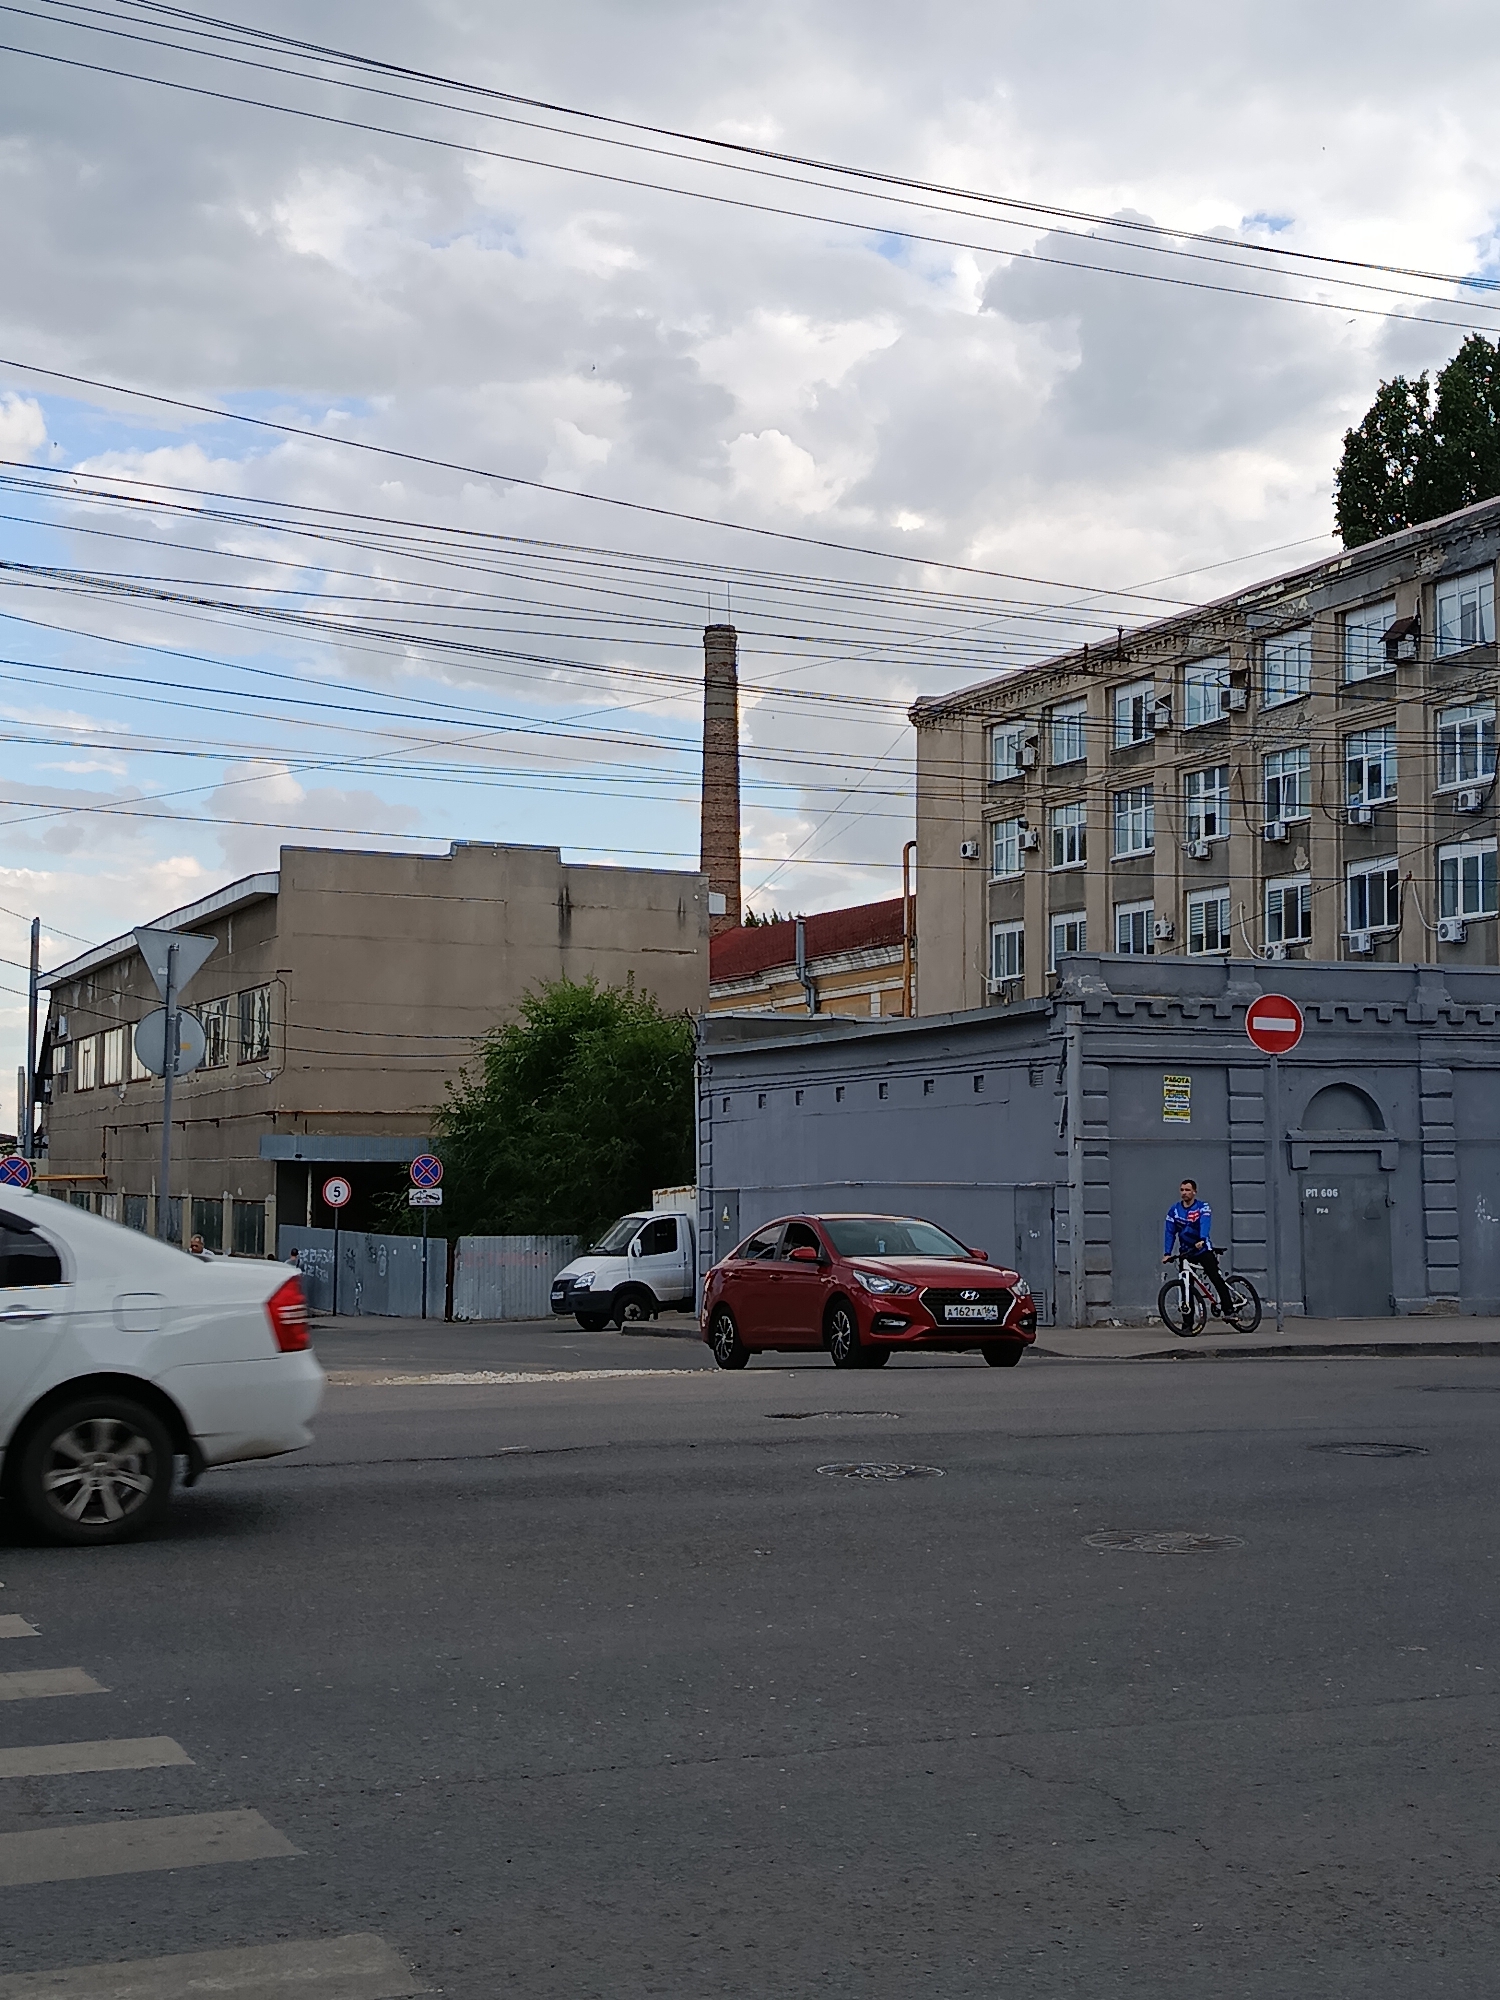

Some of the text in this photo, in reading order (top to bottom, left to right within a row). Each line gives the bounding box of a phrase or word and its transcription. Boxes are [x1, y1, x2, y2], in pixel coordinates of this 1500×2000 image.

[333, 1185, 341, 1198] 5
[1305, 1188, 1339, 1198] РП 606
